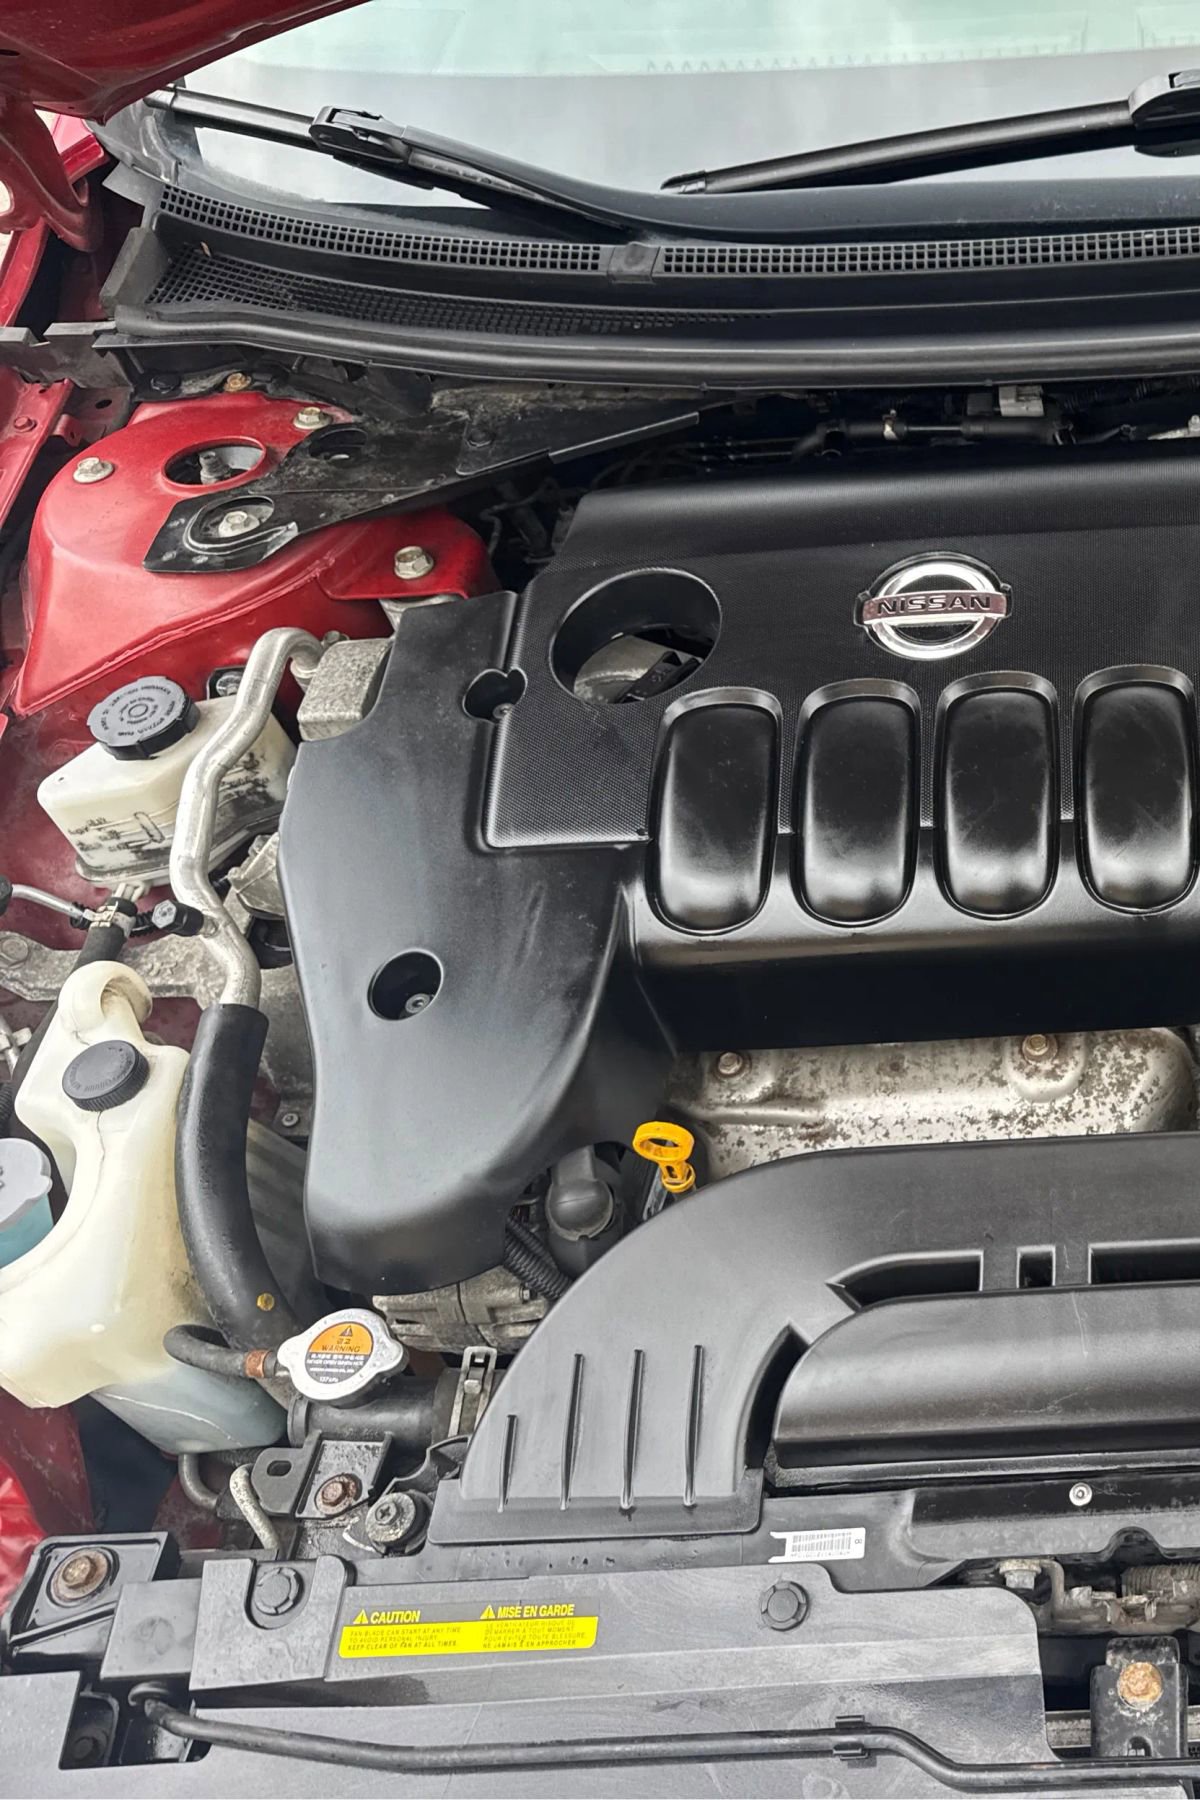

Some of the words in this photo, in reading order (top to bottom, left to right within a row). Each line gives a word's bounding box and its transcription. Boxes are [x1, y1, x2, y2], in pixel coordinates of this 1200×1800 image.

[876, 594, 992, 615] NISSAN
[322, 1345, 360, 1353] WARNING
[370, 1610, 421, 1624] CAUTION
[497, 1606, 522, 1618] MISE
[523, 1605, 538, 1617] EN
[539, 1604, 575, 1616] GARDE
